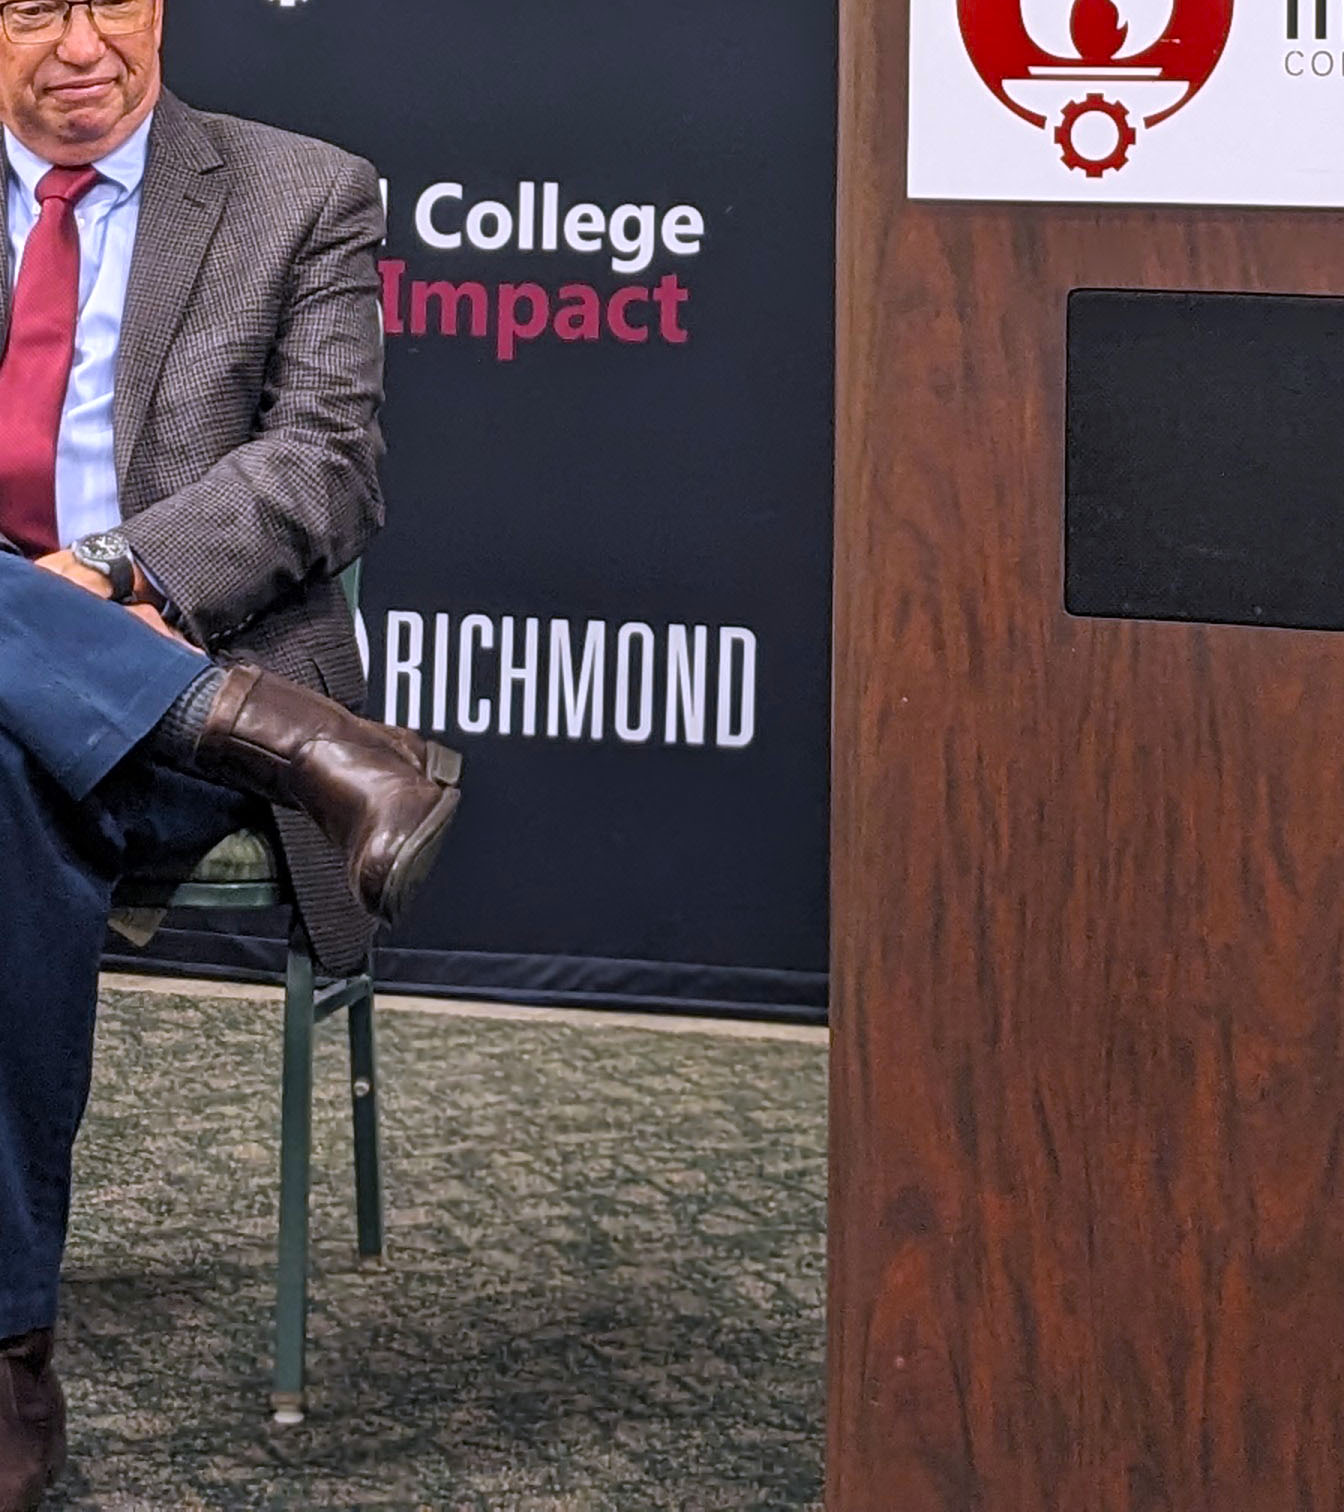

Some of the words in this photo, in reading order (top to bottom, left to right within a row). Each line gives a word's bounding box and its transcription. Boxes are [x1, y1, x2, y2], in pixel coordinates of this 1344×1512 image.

[416, 182, 703, 273] College
[378, 260, 688, 360] Impact
[385, 611, 755, 746] RICHMOND
